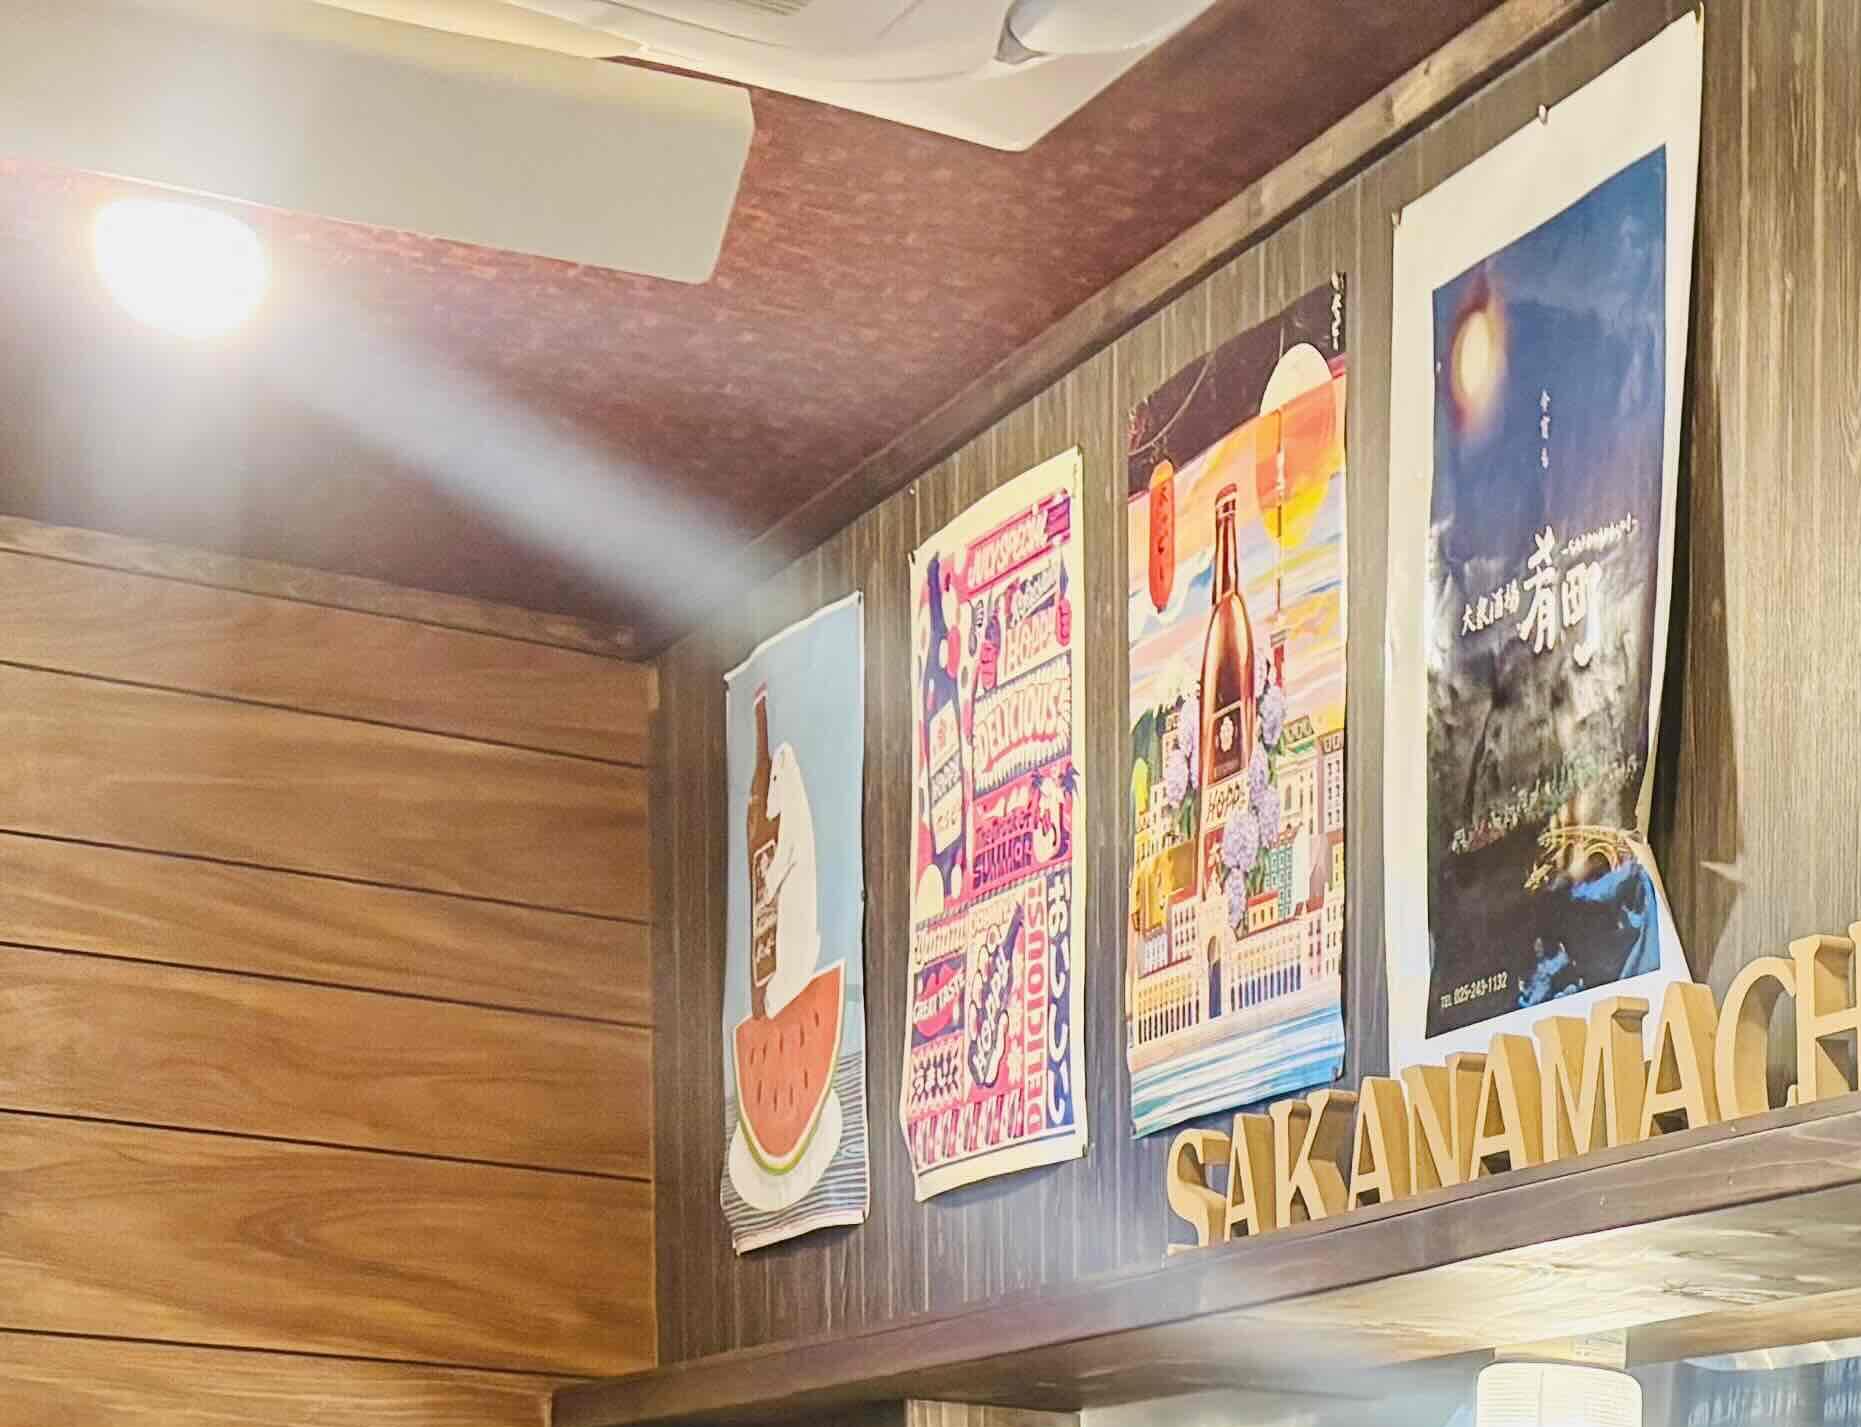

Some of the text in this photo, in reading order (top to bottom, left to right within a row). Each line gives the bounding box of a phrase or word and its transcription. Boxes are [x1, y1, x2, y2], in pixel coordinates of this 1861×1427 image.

[1519, 524, 1604, 668] 肴町
[974, 681, 1068, 776] DELICIOUS
[1026, 882, 1047, 1133] DELICIOUS
[1047, 875, 1072, 1126] おいしい
[1453, 971, 1509, 1006] 025-243-1132
